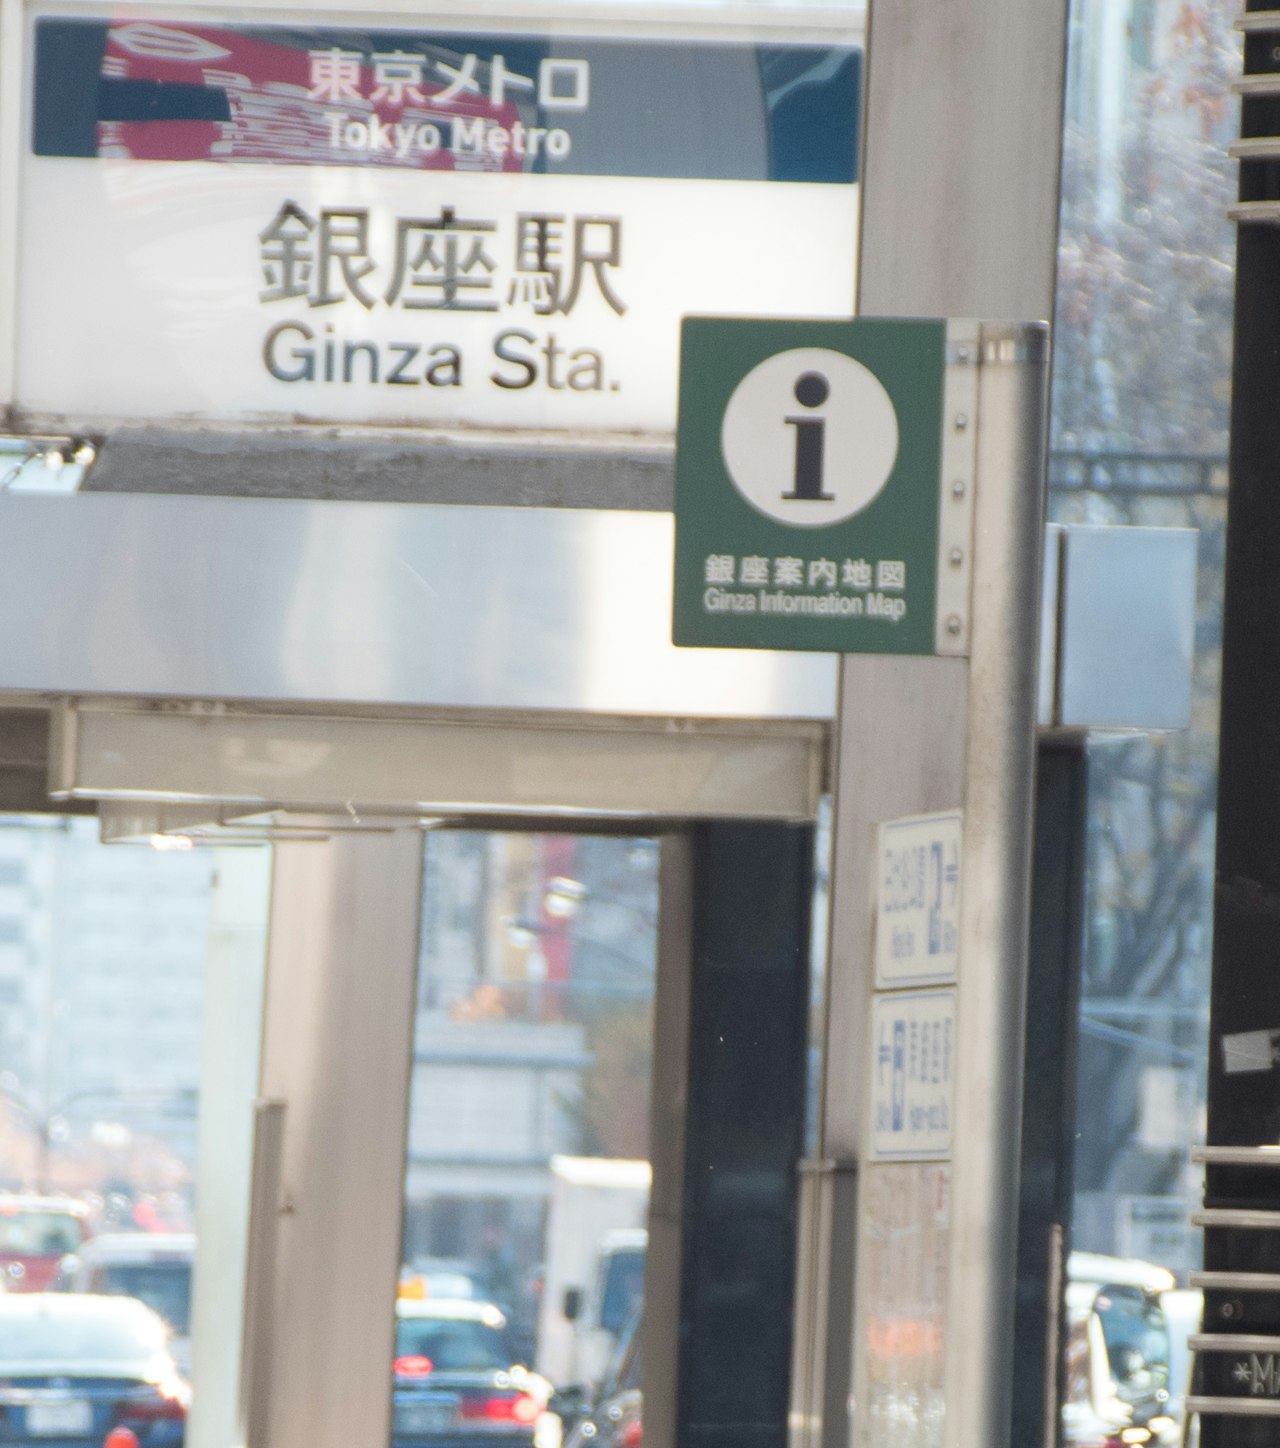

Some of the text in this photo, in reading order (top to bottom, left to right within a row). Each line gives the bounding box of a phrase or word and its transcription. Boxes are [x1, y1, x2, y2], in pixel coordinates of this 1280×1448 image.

[308, 47, 589, 107] 東京メトロ
[322, 112, 571, 158] Tokyo Metro
[257, 198, 628, 317] 銀座駅
[262, 319, 621, 392] Ginza Sta.
[704, 554, 906, 590] 銀座案内地図
[704, 587, 907, 623] Ginza Information Map
